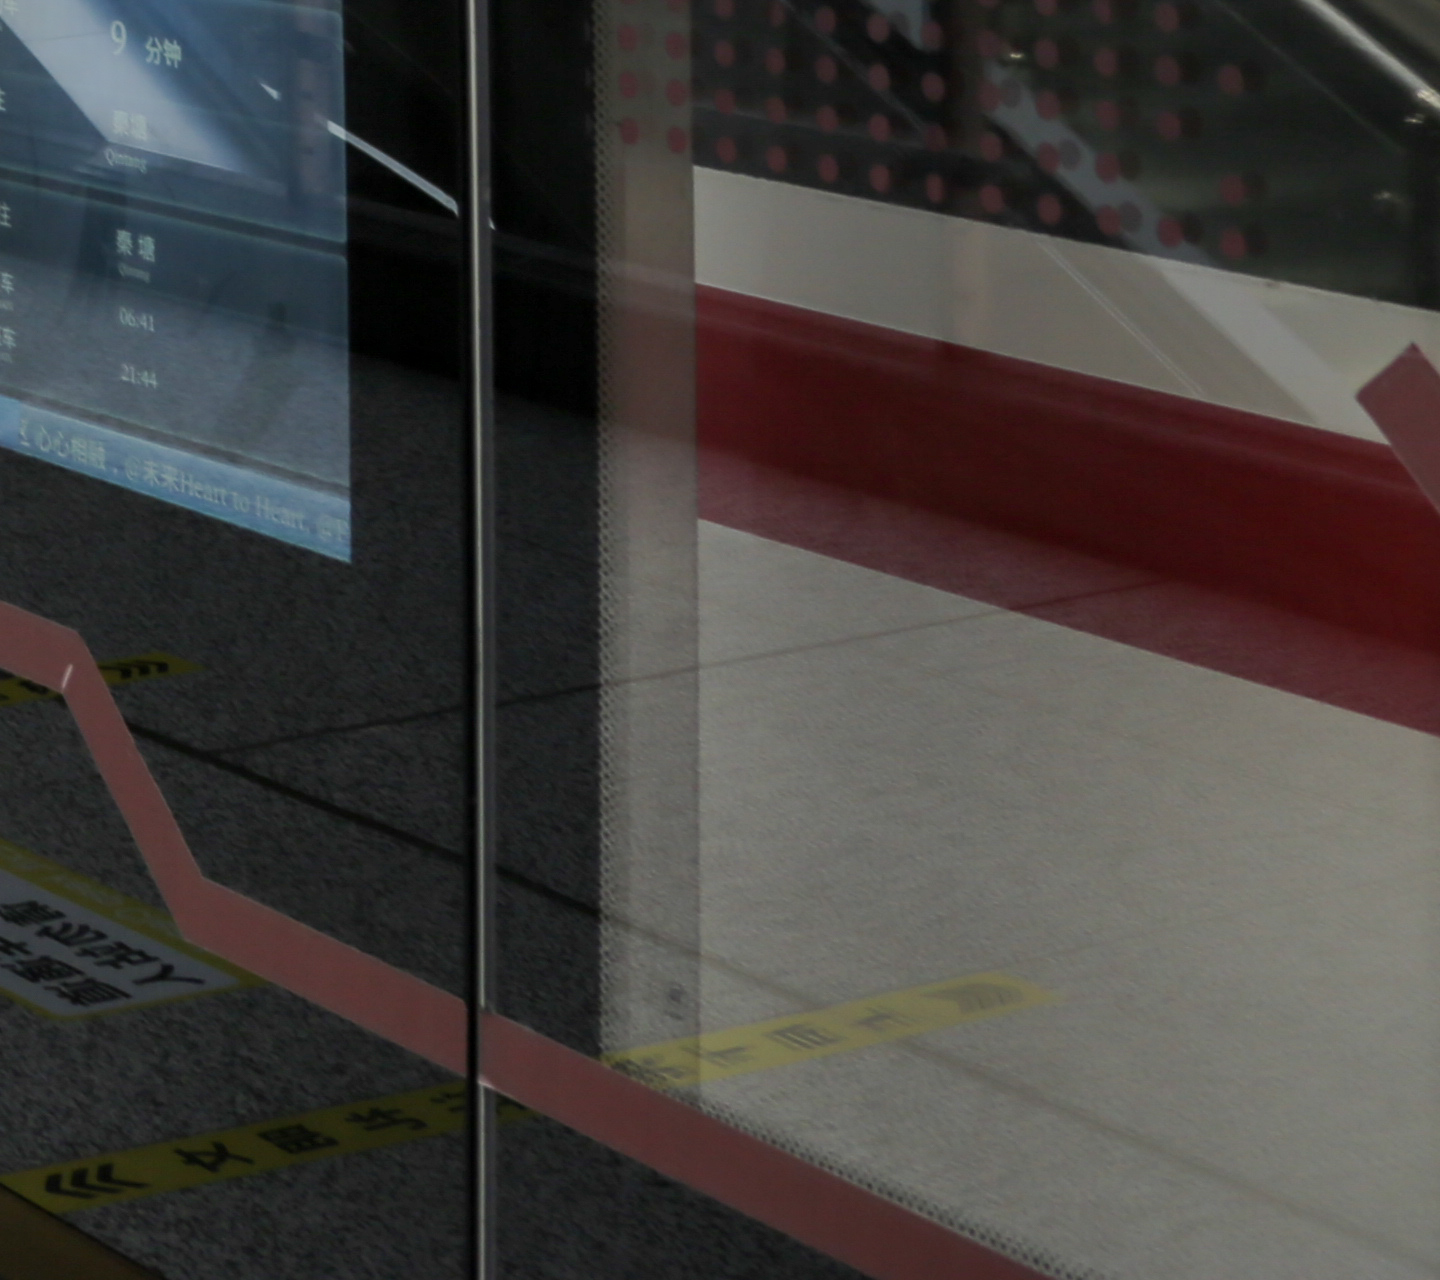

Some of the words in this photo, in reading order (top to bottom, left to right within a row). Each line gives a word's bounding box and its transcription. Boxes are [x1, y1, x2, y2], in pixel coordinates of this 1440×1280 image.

[109, 19, 126, 58] 9
[144, 37, 182, 71] 分钟
[120, 363, 158, 389] 21:44
